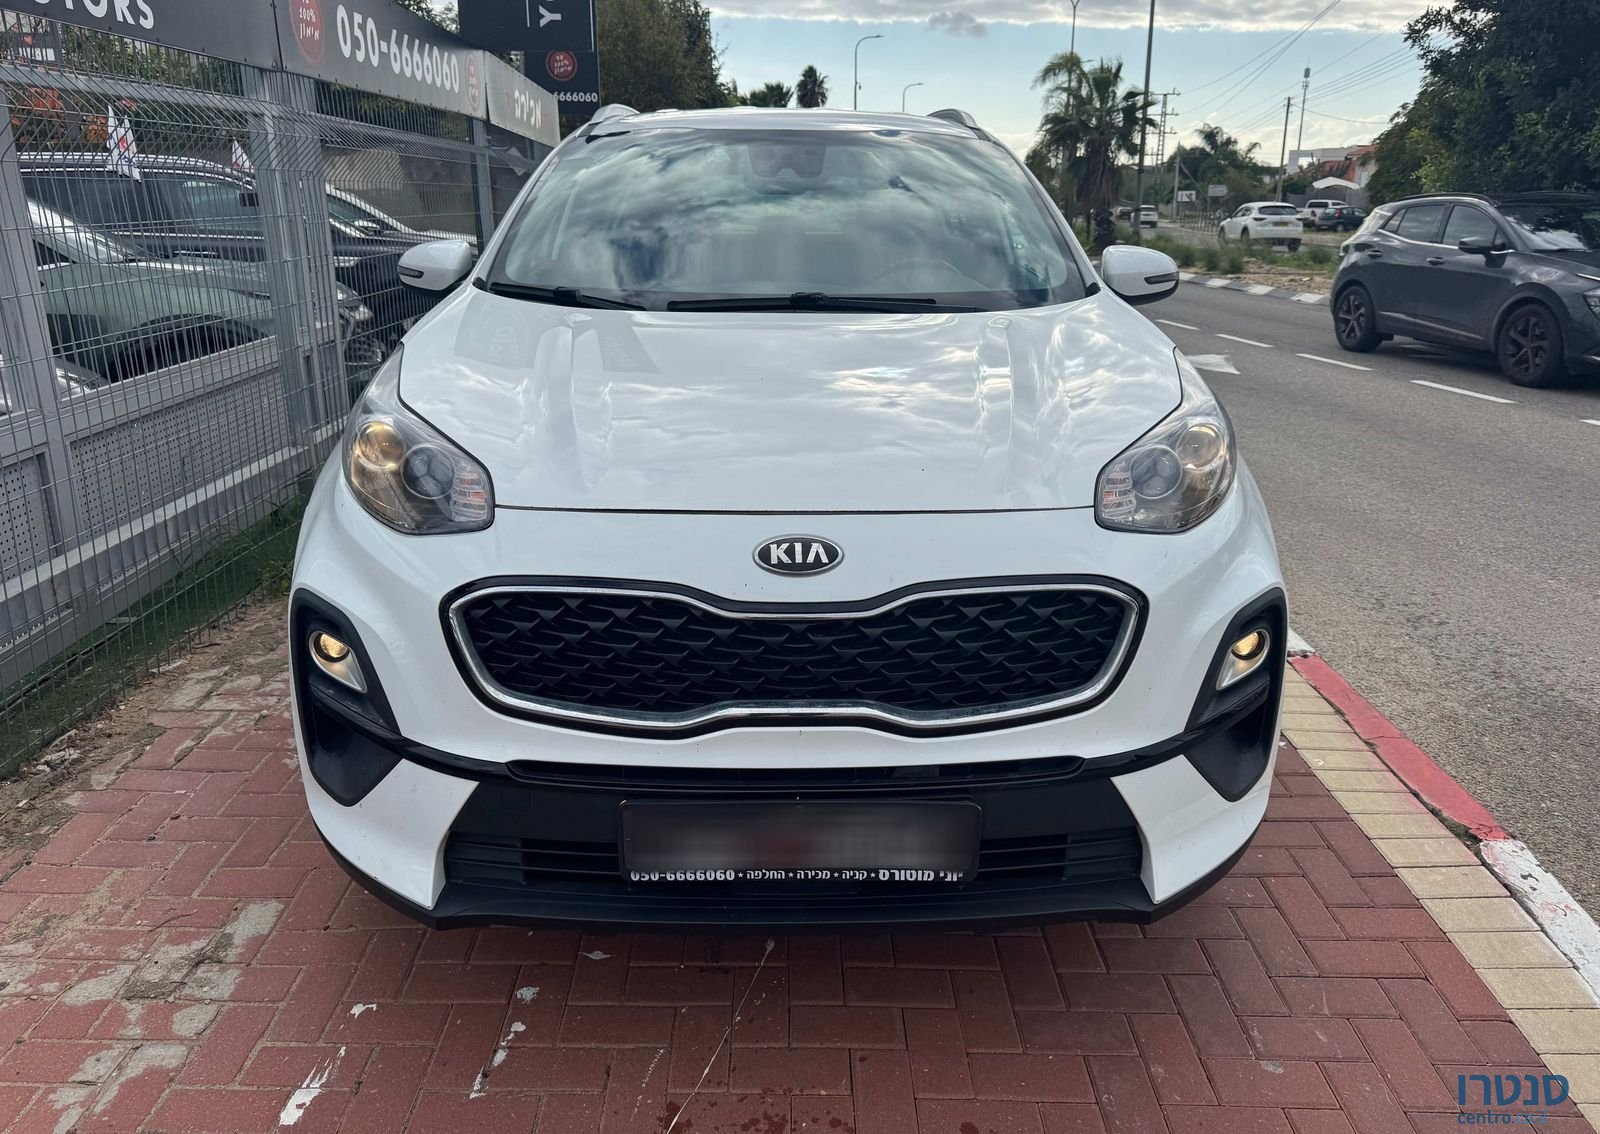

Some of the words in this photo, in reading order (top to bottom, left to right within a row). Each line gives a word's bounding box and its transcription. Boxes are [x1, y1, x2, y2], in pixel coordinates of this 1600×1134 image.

[299, 6, 316, 23] 100%
[336, 4, 460, 94] 050-6666060
[769, 542, 829, 564] KIA
[746, 868, 785, 880] החלפה
[796, 869, 831, 880] מכירה
[842, 869, 868, 881] קניה
[878, 869, 935, 882] מוטורס
